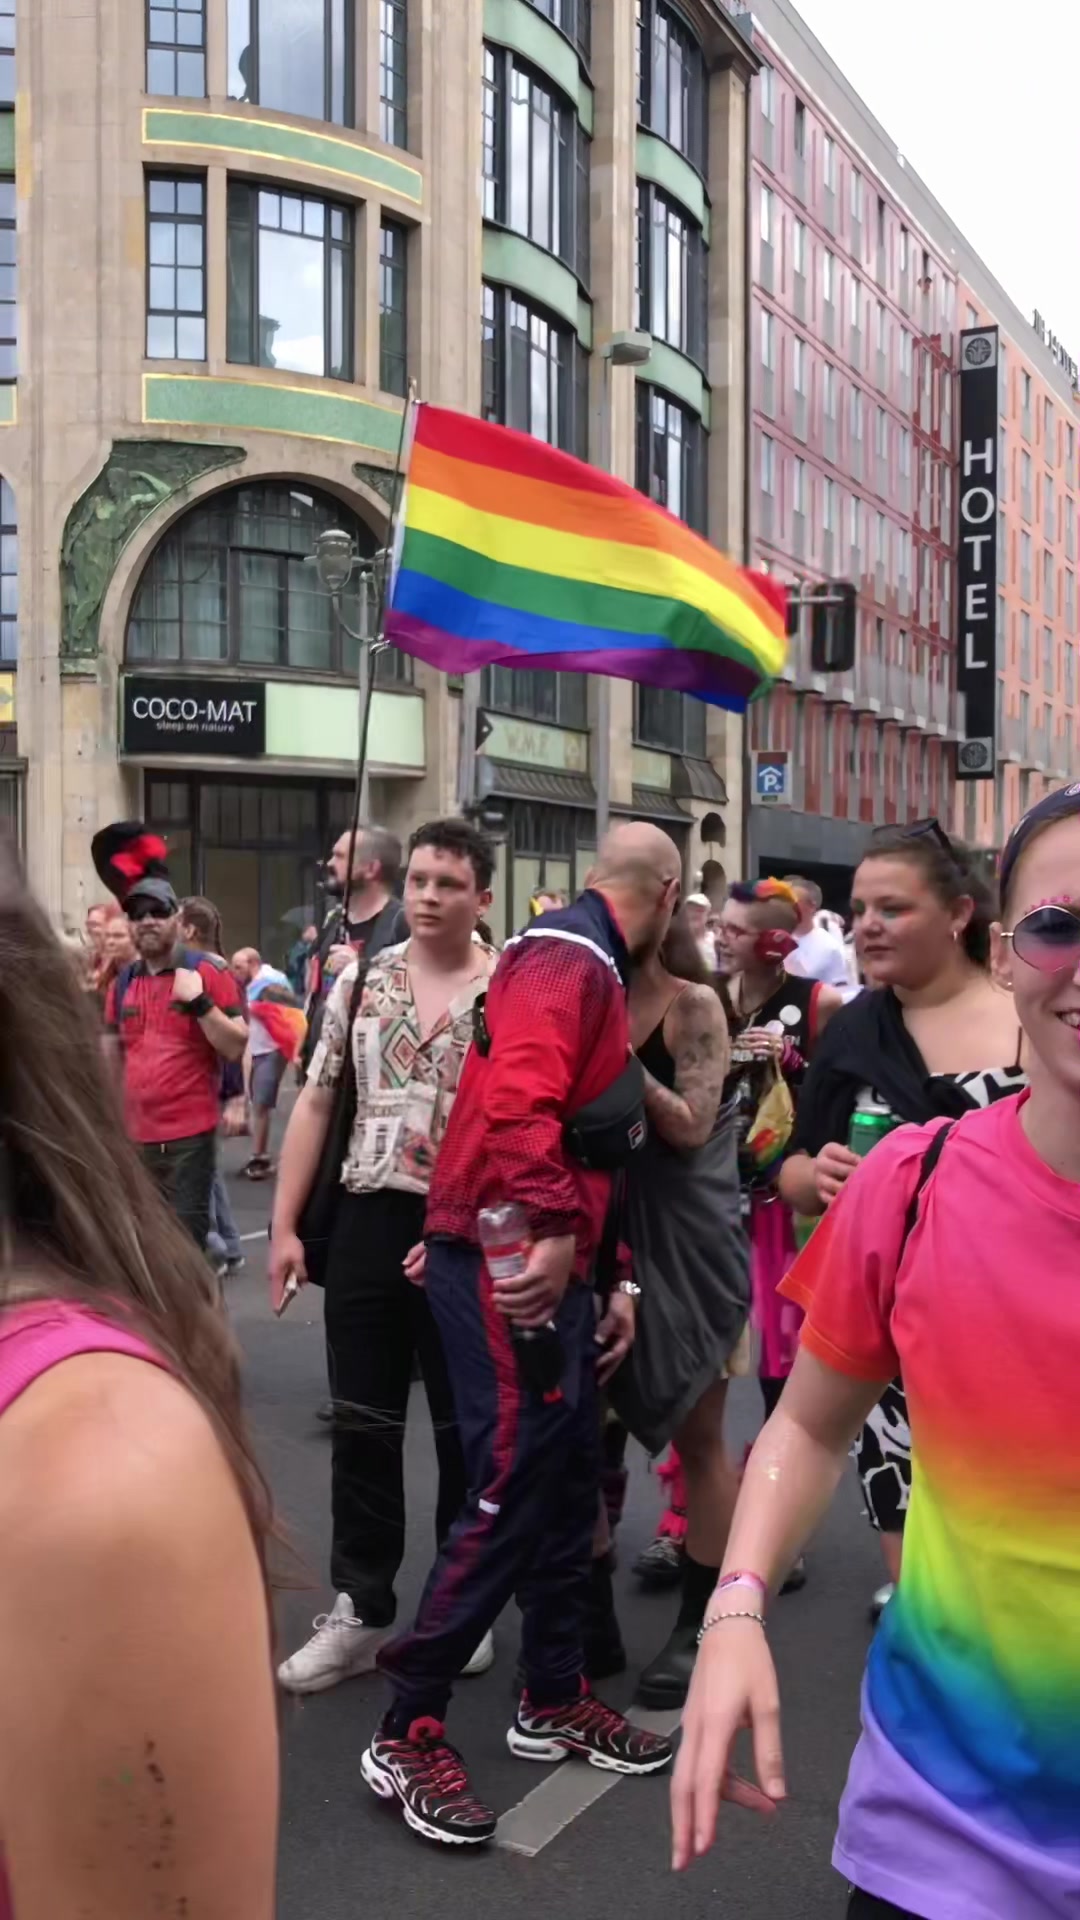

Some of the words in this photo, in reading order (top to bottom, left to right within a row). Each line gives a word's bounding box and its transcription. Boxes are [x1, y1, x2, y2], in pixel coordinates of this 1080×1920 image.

[961, 438, 994, 669] HOTEL
[132, 697, 257, 722] COCO-MAT
[156, 720, 184, 732] sleep
[201, 722, 235, 733] nature
[764, 774, 778, 792] P
